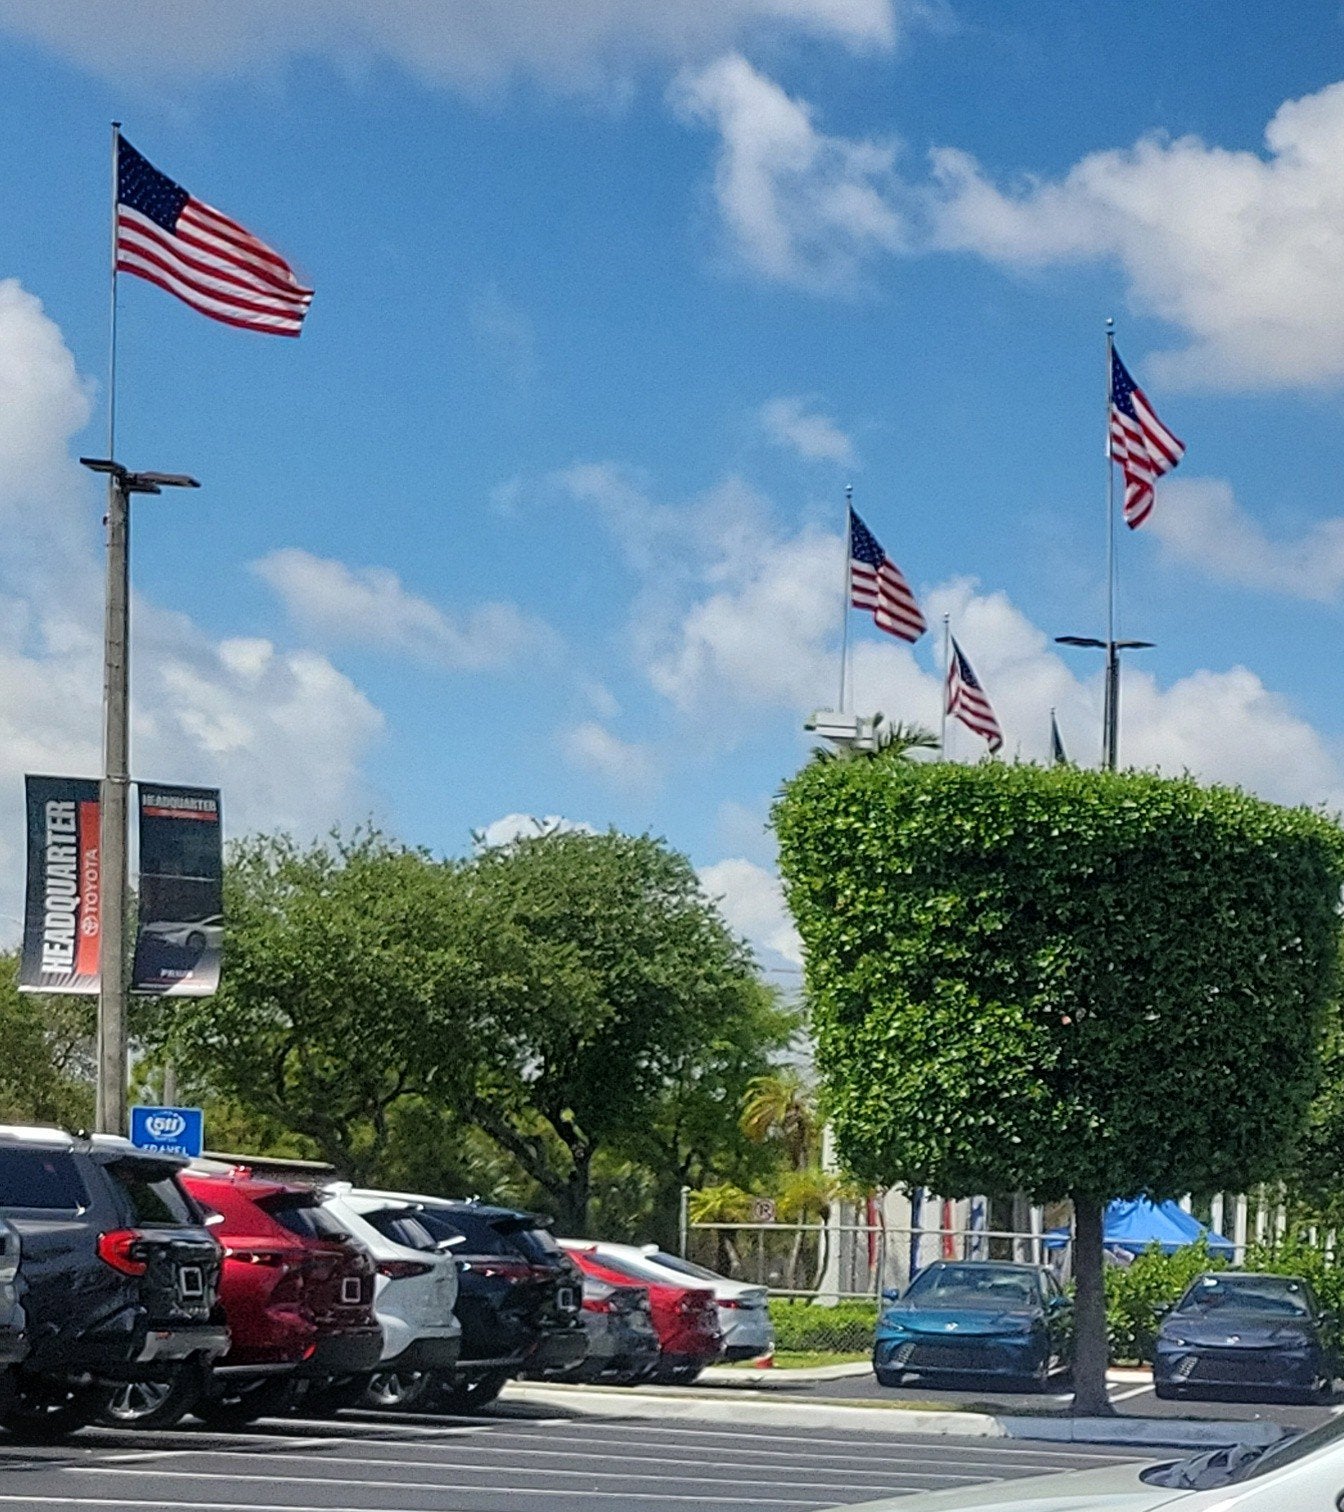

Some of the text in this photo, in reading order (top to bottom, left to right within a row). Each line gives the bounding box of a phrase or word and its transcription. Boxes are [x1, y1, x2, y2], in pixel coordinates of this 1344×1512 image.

[42, 801, 80, 973] HEADQUARTER
[85, 849, 99, 913] TOYOTA
[153, 1117, 178, 1132] 511
